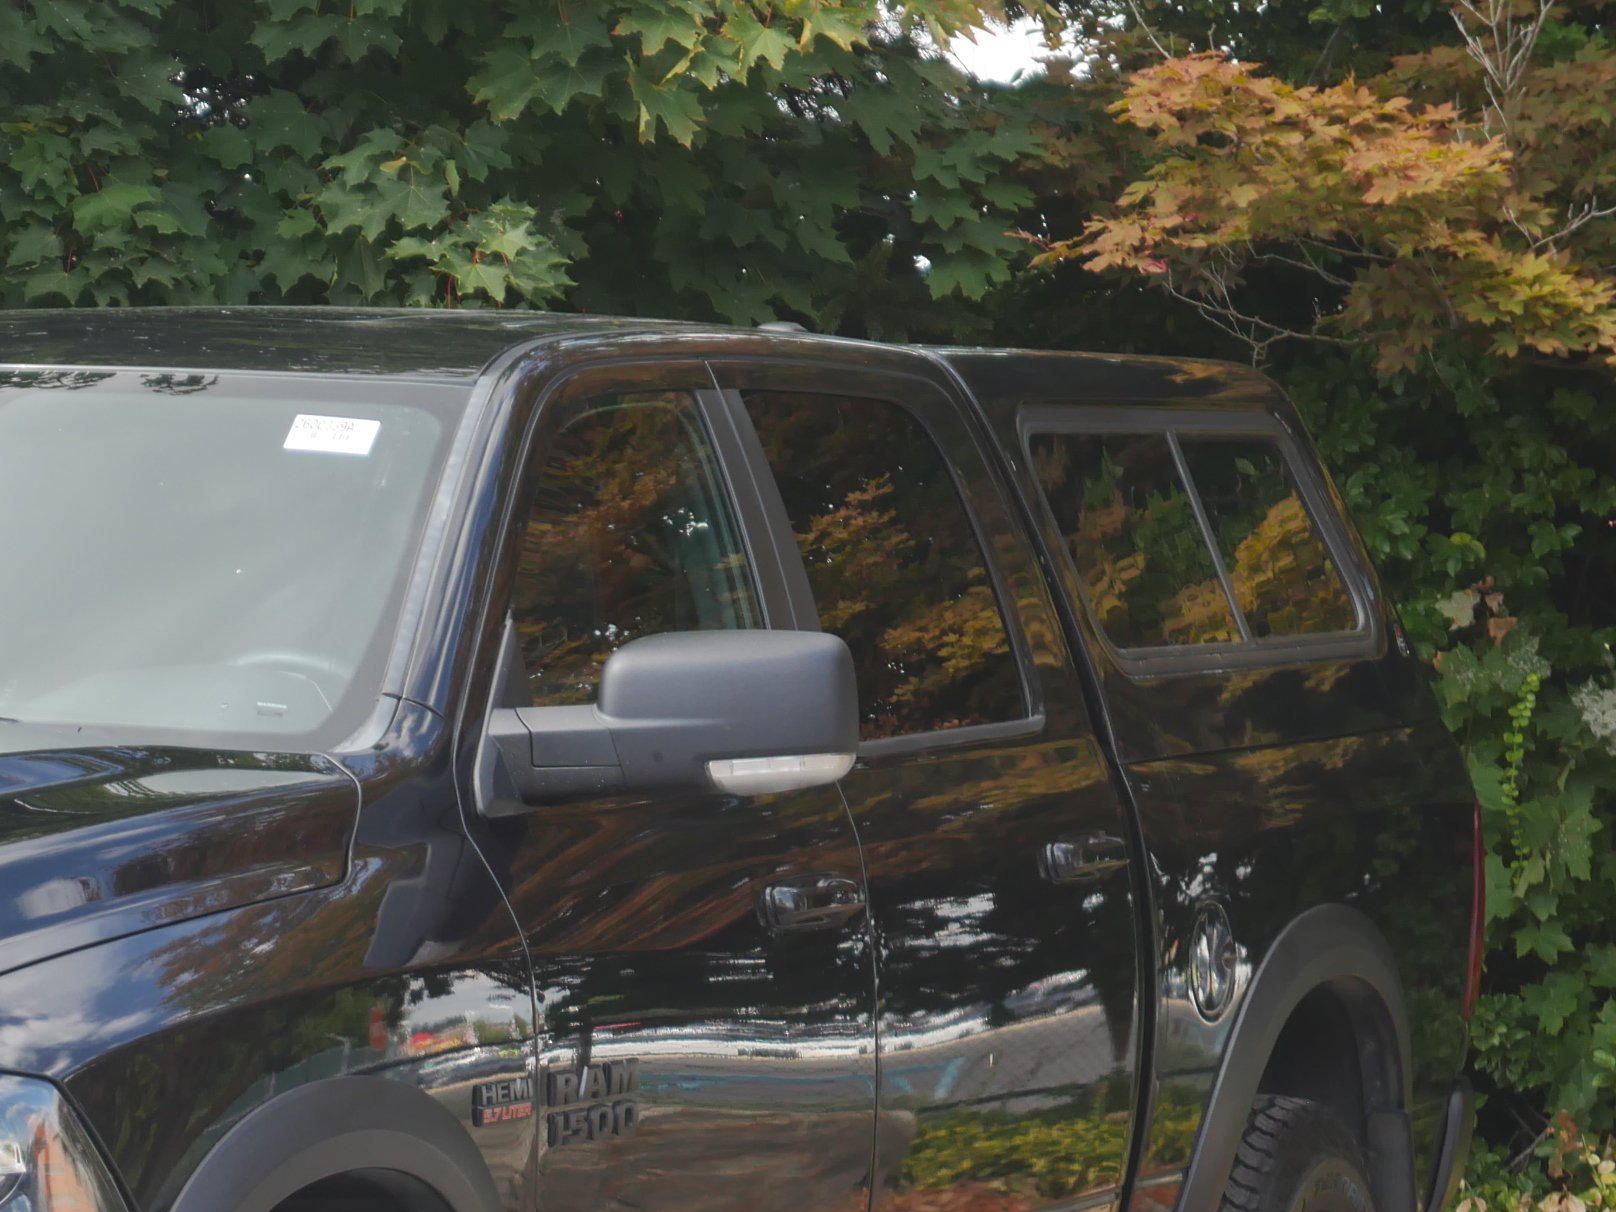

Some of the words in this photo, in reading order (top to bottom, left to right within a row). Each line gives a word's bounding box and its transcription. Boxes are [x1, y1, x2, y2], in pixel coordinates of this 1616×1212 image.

[480, 1078, 534, 1106] HEMI
[547, 1058, 639, 1107] RAM
[547, 1100, 639, 1148] 1500
